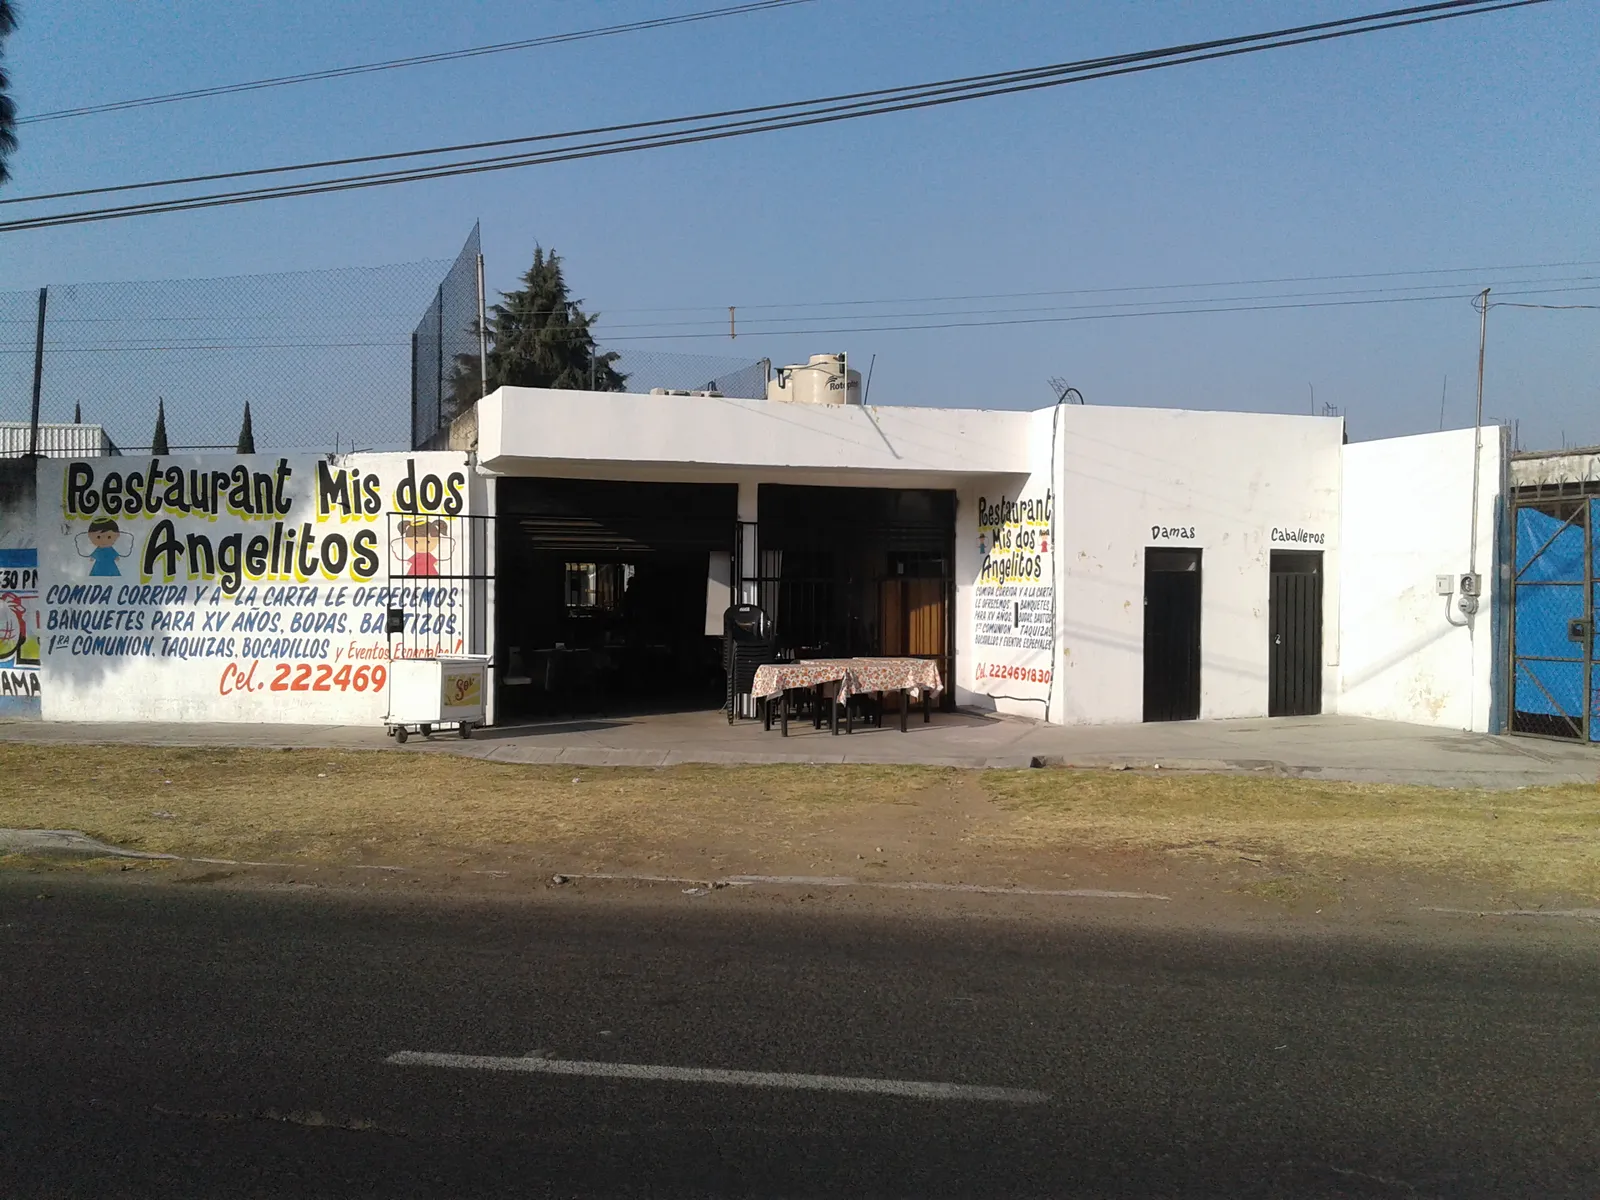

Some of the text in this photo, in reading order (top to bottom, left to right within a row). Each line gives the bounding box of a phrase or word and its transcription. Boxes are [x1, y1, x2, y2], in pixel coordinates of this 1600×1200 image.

[68, 459, 465, 517] Restaurant Mis dos
[979, 488, 1052, 527] Restaurant
[993, 525, 1035, 549] Mis dos
[1151, 525, 1196, 540] Damas
[1271, 527, 1325, 544] Caballeros
[143, 519, 380, 594] Angelitos
[981, 551, 1041, 585] Angelitos
[46, 584, 113, 606] COMIDA
[117, 585, 188, 607] CORRIDA
[194, 585, 209, 606] Y
[210, 586, 222, 606] A
[234, 586, 257, 606] LA
[263, 586, 319, 607] CARTA
[324, 586, 348, 607] LE
[47, 609, 145, 634] BANQUETES
[151, 611, 194, 631] PARA
[202, 611, 231, 632] XV
[231, 607, 284, 635] AÑOS,
[359, 612, 462, 636] BATIZOS,
[242, 638, 330, 659] BOCADILLOS
[335, 647, 345, 664] y
[347, 640, 391, 660] Eventos
[219, 660, 388, 696] Cel. 222469
[989, 663, 1051, 684] 2224691830
